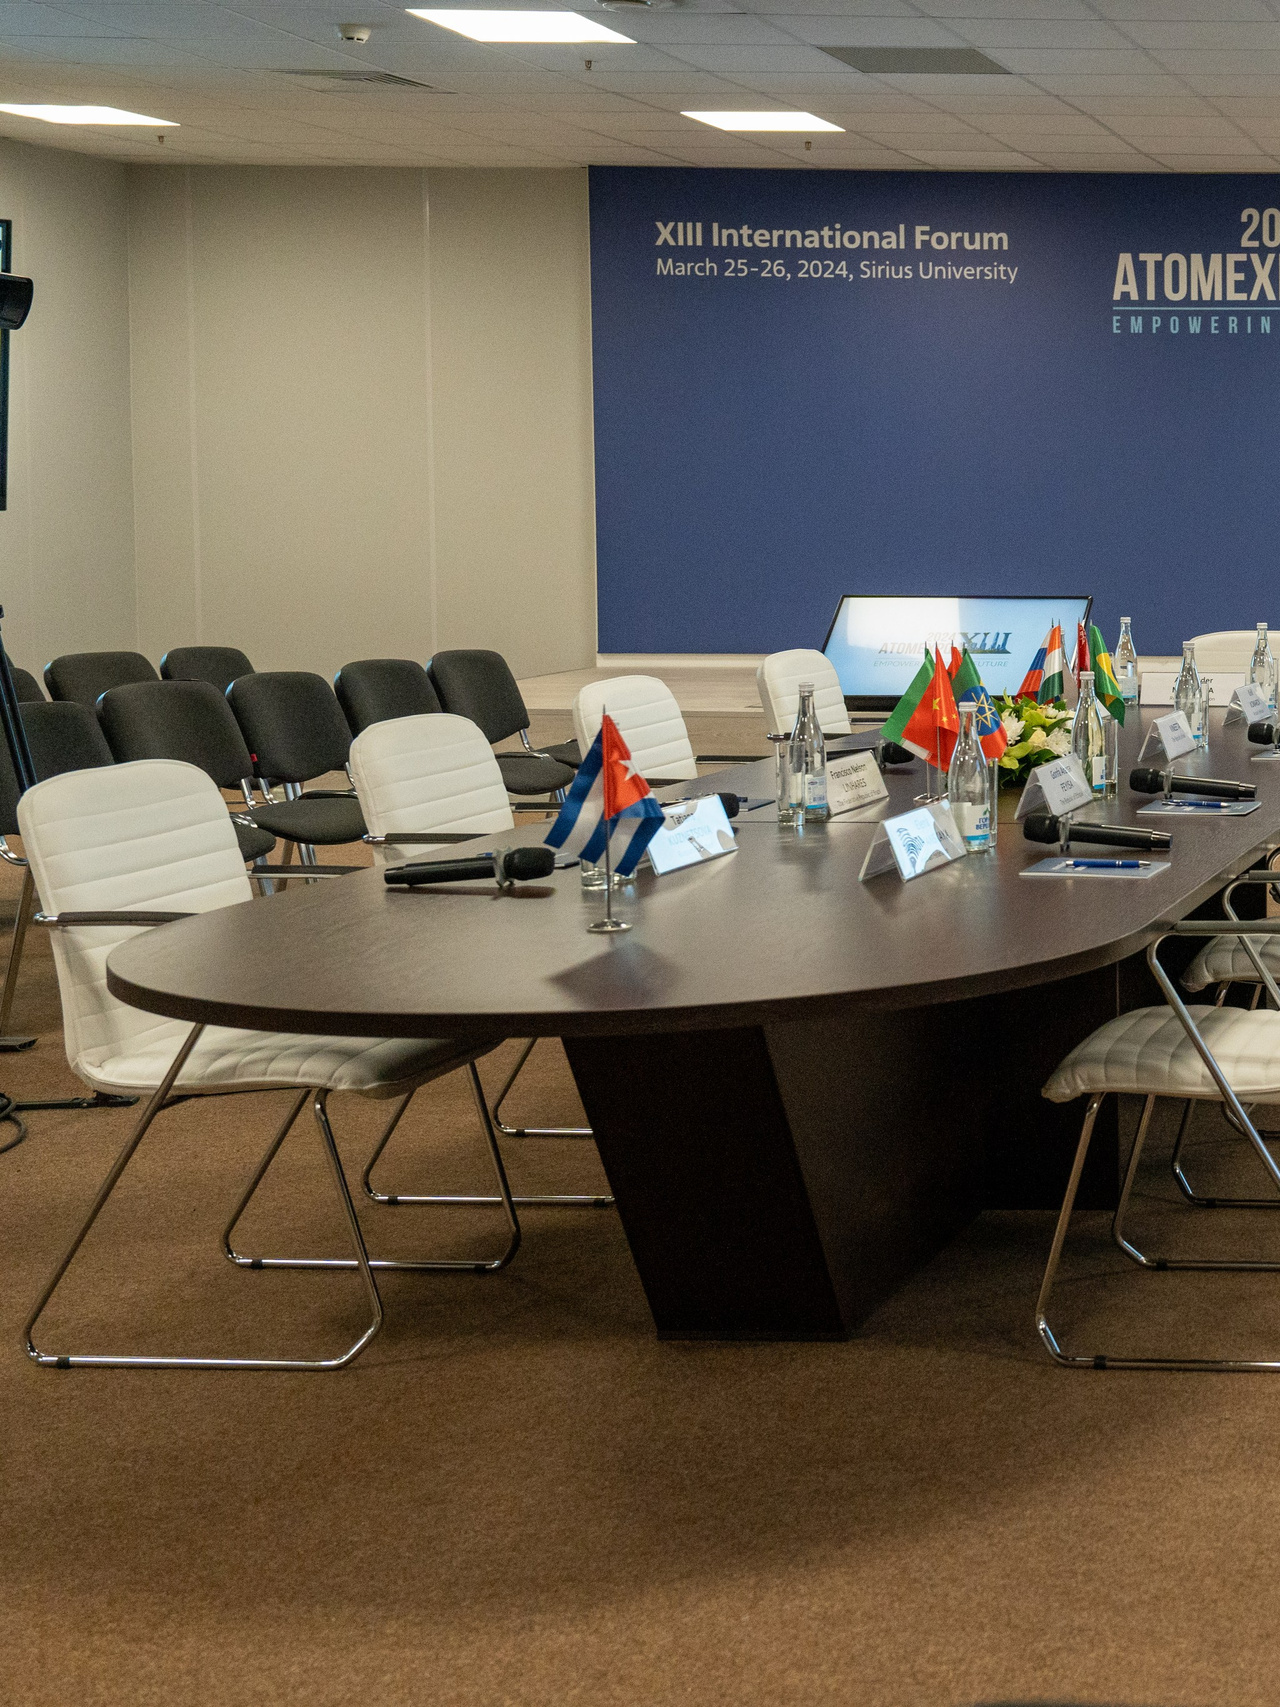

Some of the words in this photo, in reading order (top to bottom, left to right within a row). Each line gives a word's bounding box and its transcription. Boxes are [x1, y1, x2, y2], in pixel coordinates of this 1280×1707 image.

[655, 221, 703, 247] XIII
[712, 221, 905, 249] International
[915, 225, 1009, 250] Forum
[655, 257, 718, 277] March
[723, 259, 792, 281] 25-26,
[797, 260, 854, 282] 2024,
[859, 261, 913, 279] Sirius
[919, 261, 1018, 284] University
[829, 765, 852, 780] Francisco
[850, 761, 867, 774] Nelson
[842, 777, 867, 792] LINHARES
